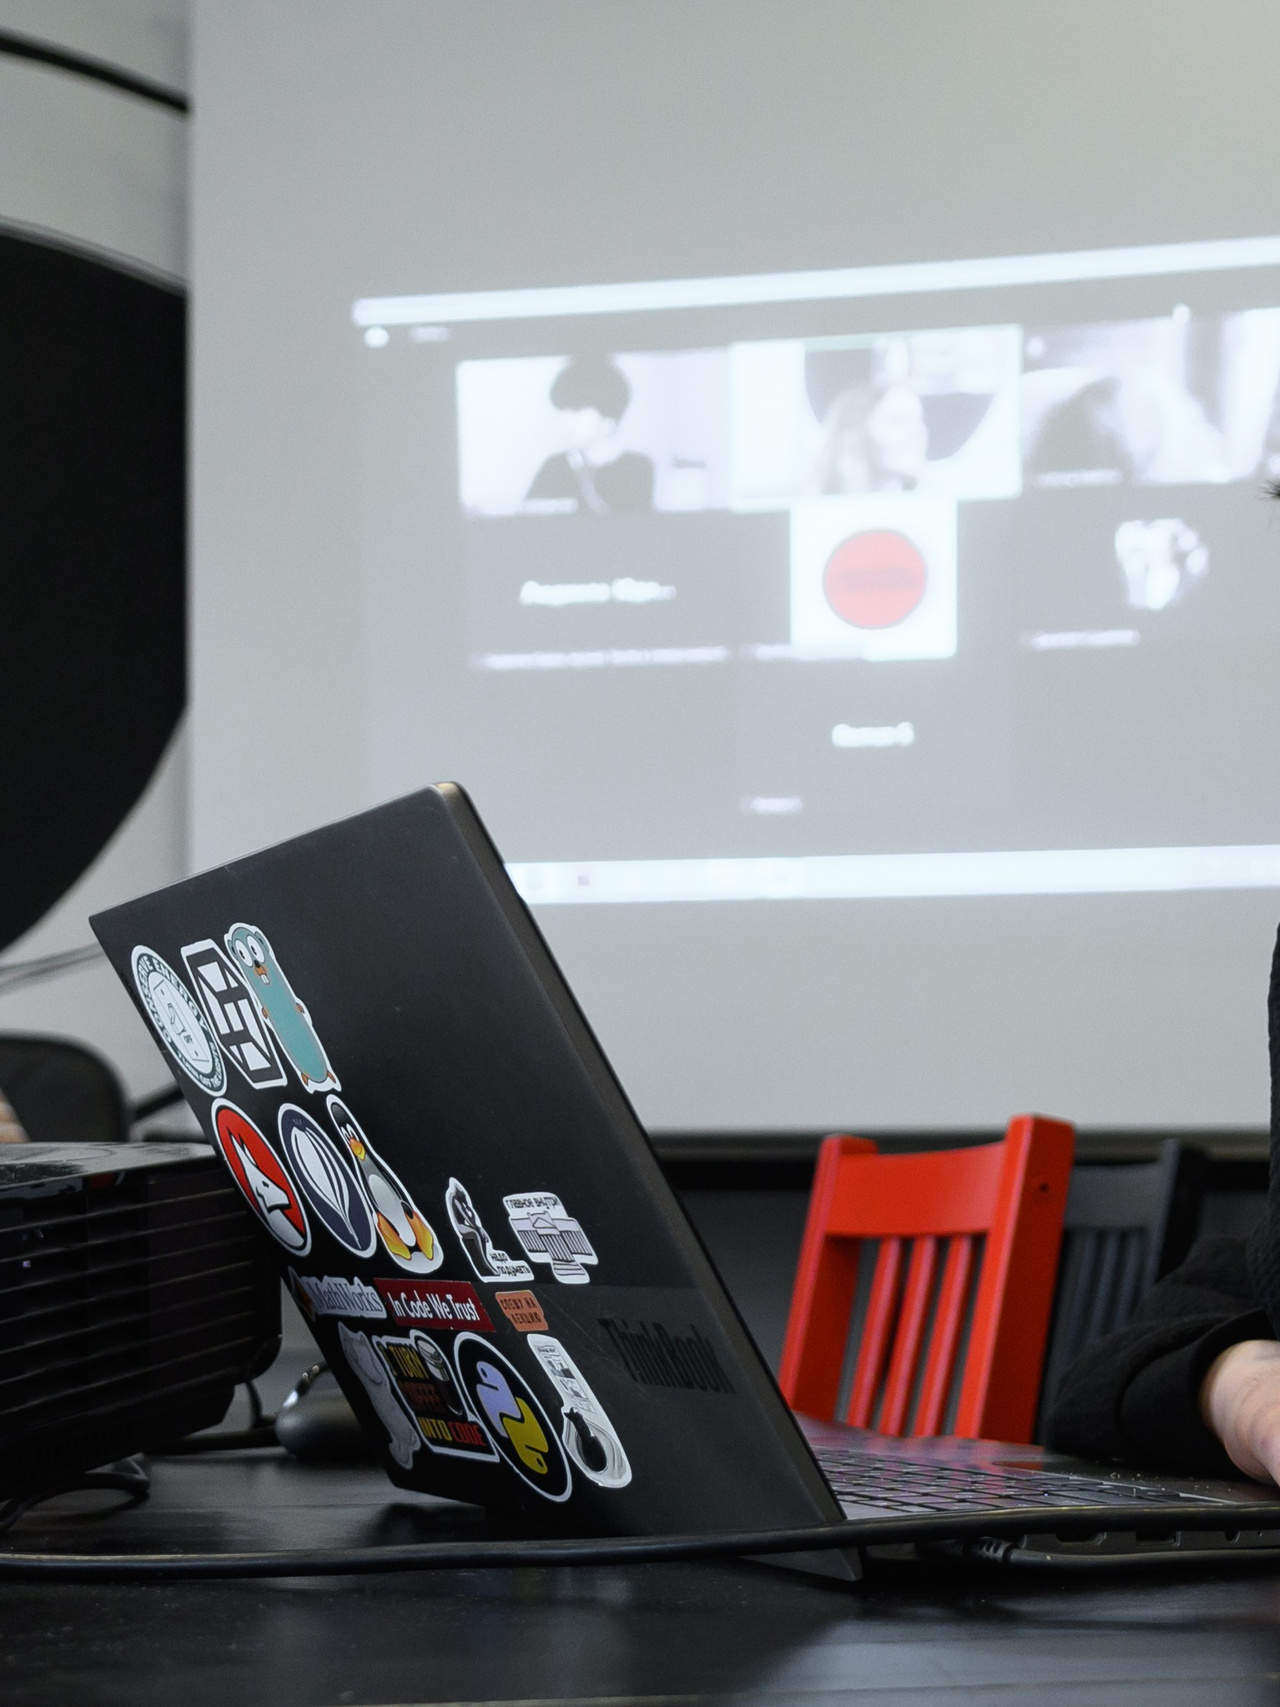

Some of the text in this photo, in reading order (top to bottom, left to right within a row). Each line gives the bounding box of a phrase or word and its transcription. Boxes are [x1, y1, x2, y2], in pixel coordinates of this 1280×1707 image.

[152, 957, 210, 1031] ENERGY
[308, 1281, 383, 1313] MathWorks
[387, 1290, 481, 1321] In Code We Trust
[387, 1345, 429, 1379] TURN
[597, 1318, 736, 1394] ThinkBook
[417, 1416, 488, 1446] INTO CODE
